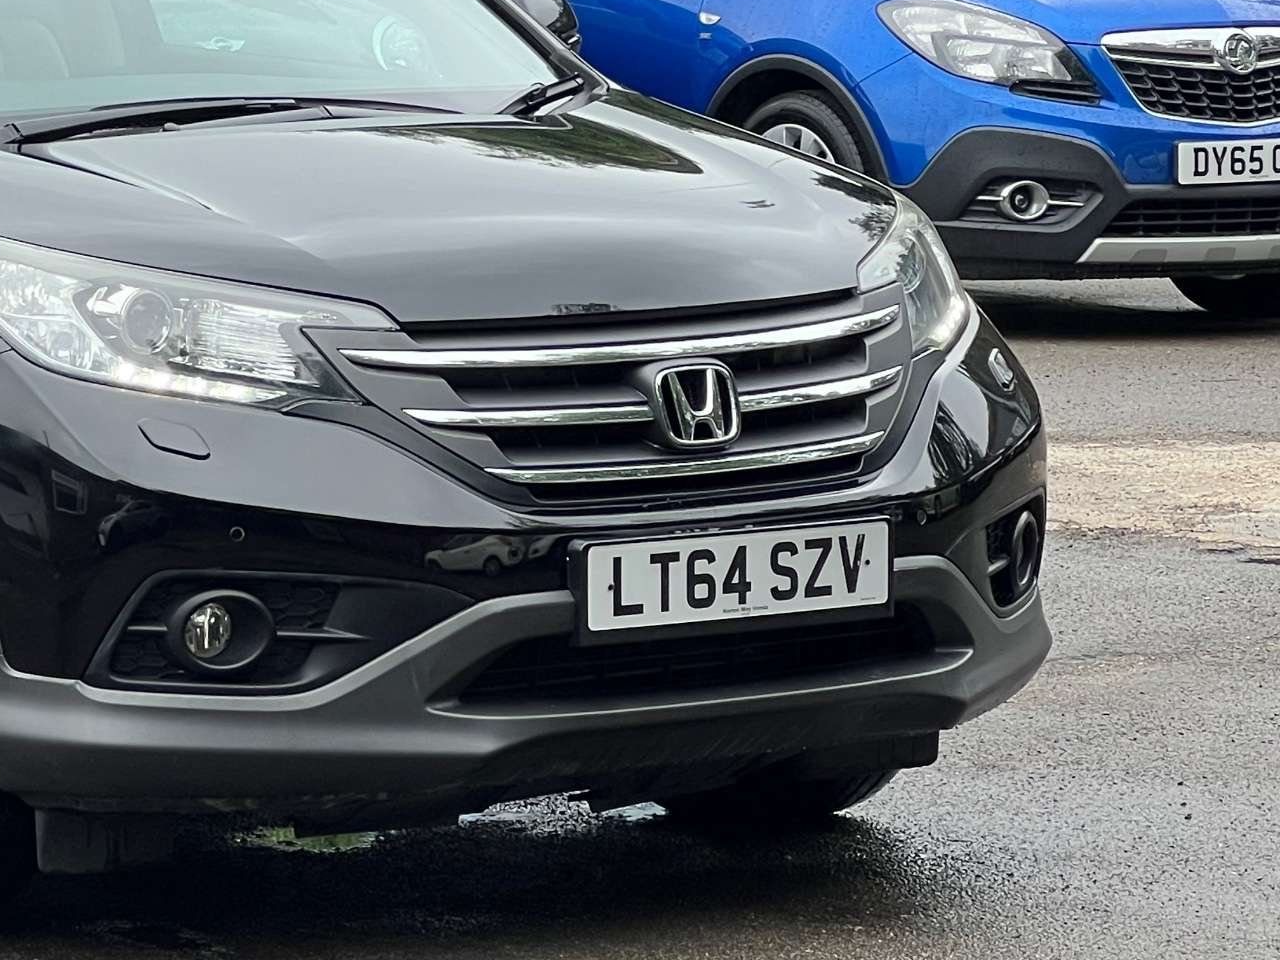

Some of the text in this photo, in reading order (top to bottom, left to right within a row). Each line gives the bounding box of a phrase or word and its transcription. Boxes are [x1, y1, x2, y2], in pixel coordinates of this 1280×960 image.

[1193, 145, 1264, 177] DY65
[613, 534, 866, 617] LT64 SZV
